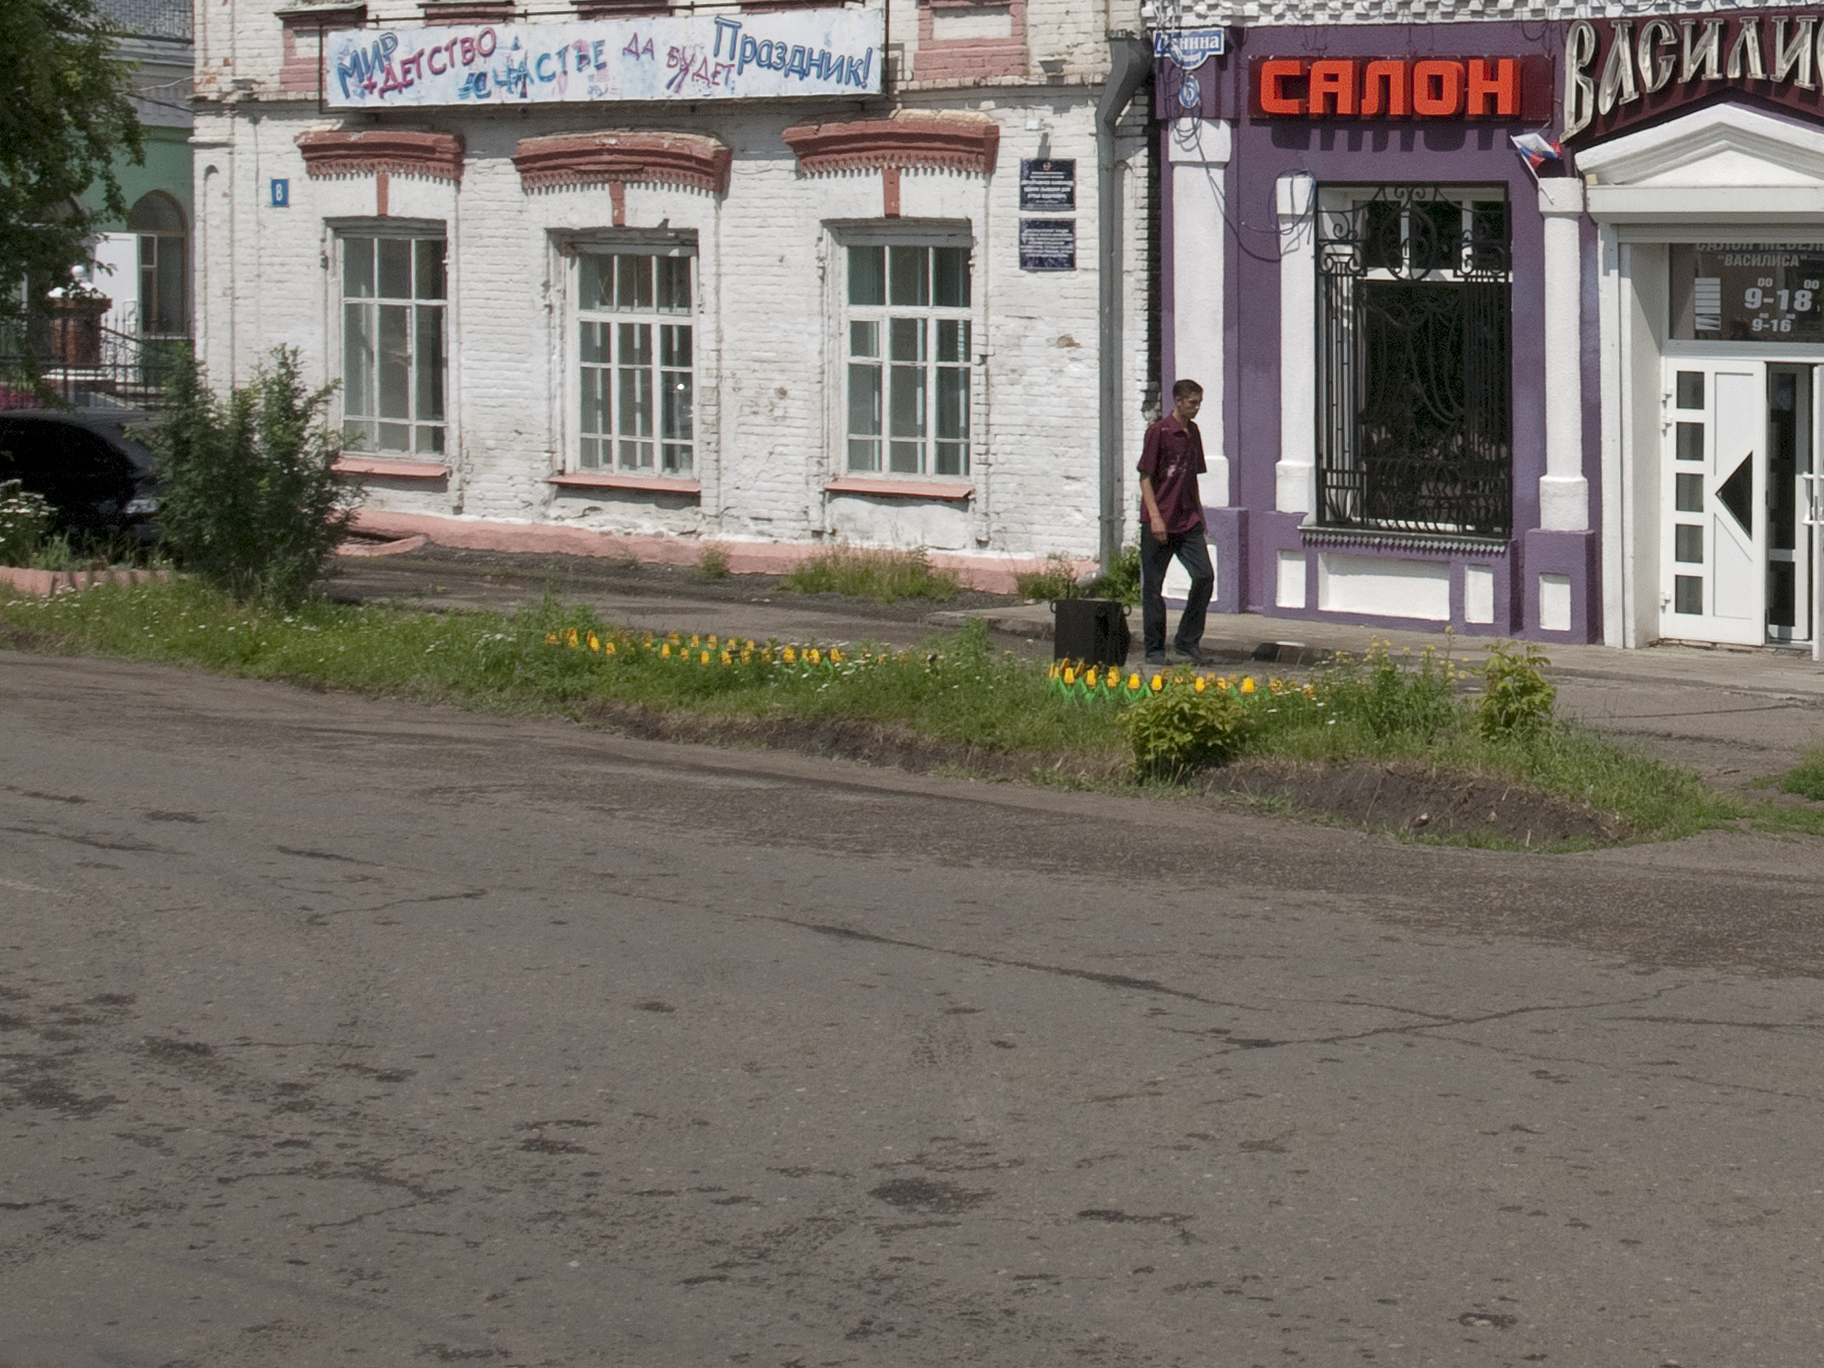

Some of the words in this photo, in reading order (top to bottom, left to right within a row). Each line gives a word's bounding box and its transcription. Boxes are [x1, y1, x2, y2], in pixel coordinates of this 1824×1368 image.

[338, 32, 398, 99] МИР
[378, 27, 497, 99] ДЕТСТВО
[622, 32, 655, 61] ДА
[714, 16, 873, 89] Праздник!
[1260, 58, 1521, 116] САЛОН
[1718, 254, 1808, 267] "ВАСИЛИСА"
